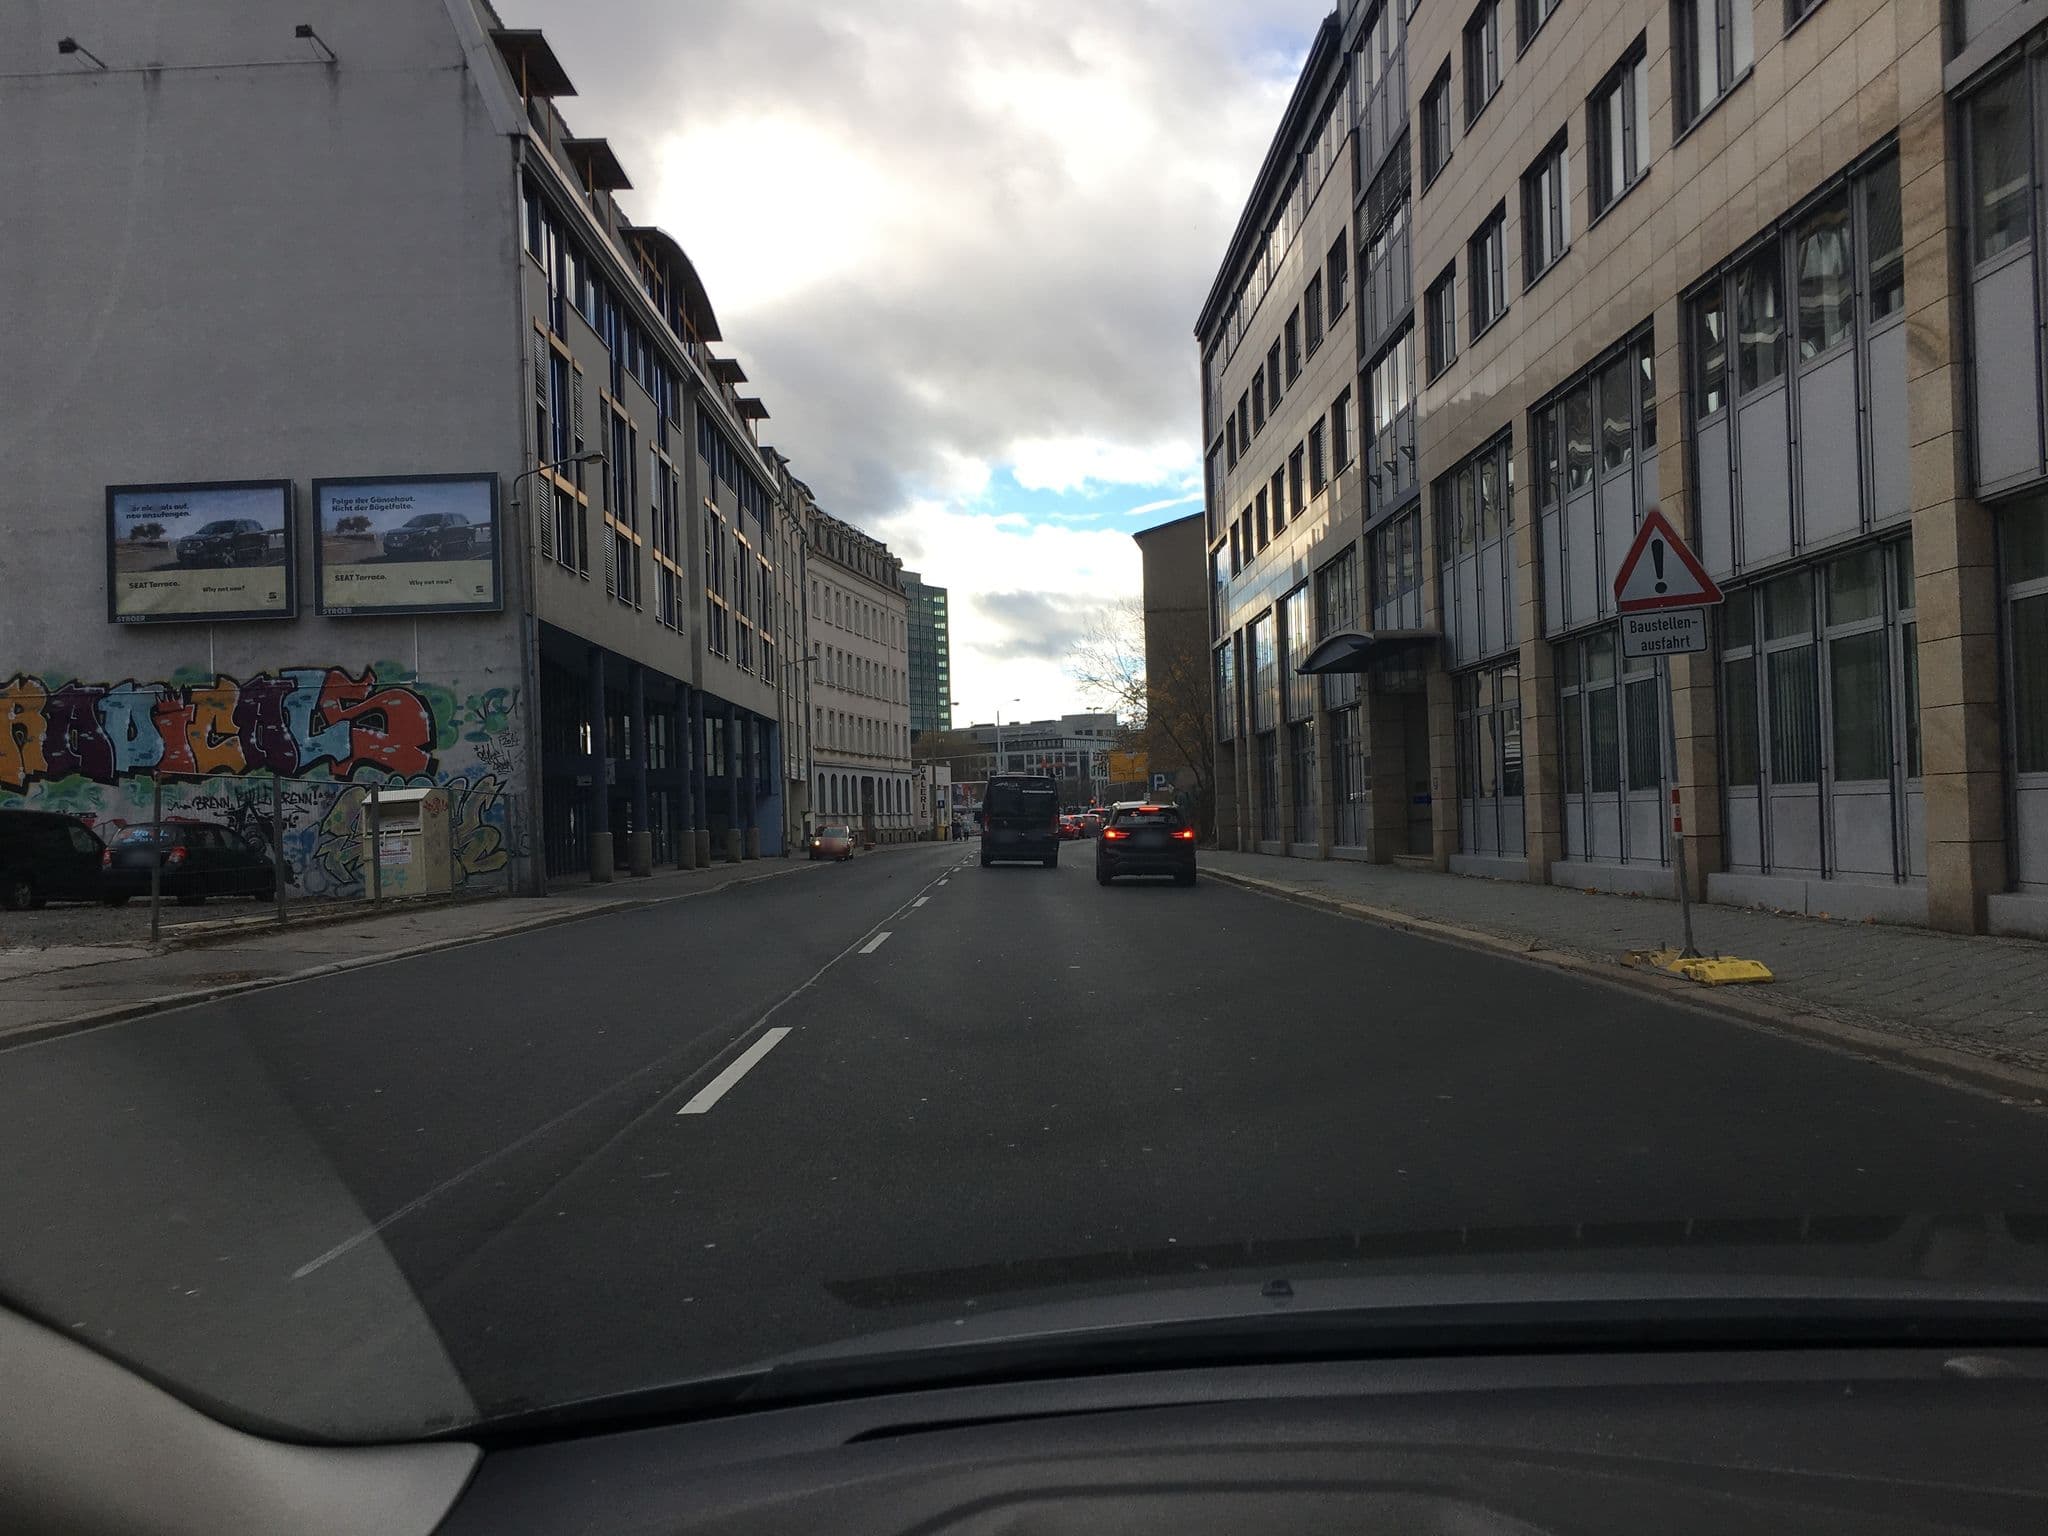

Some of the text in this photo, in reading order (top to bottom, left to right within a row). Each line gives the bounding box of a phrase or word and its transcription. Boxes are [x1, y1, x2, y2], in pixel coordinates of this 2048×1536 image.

[331, 496, 354, 506] Folge
[355, 496, 369, 504] der
[331, 503, 353, 512] Nicht
[354, 503, 368, 511] der
[335, 574, 354, 582] SEAT
[1630, 617, 1698, 634] Baustellen-
[1641, 635, 1690, 651] ausfahrt
[1154, 774, 1165, 791] P
[919, 765, 928, 819] GALERIE
